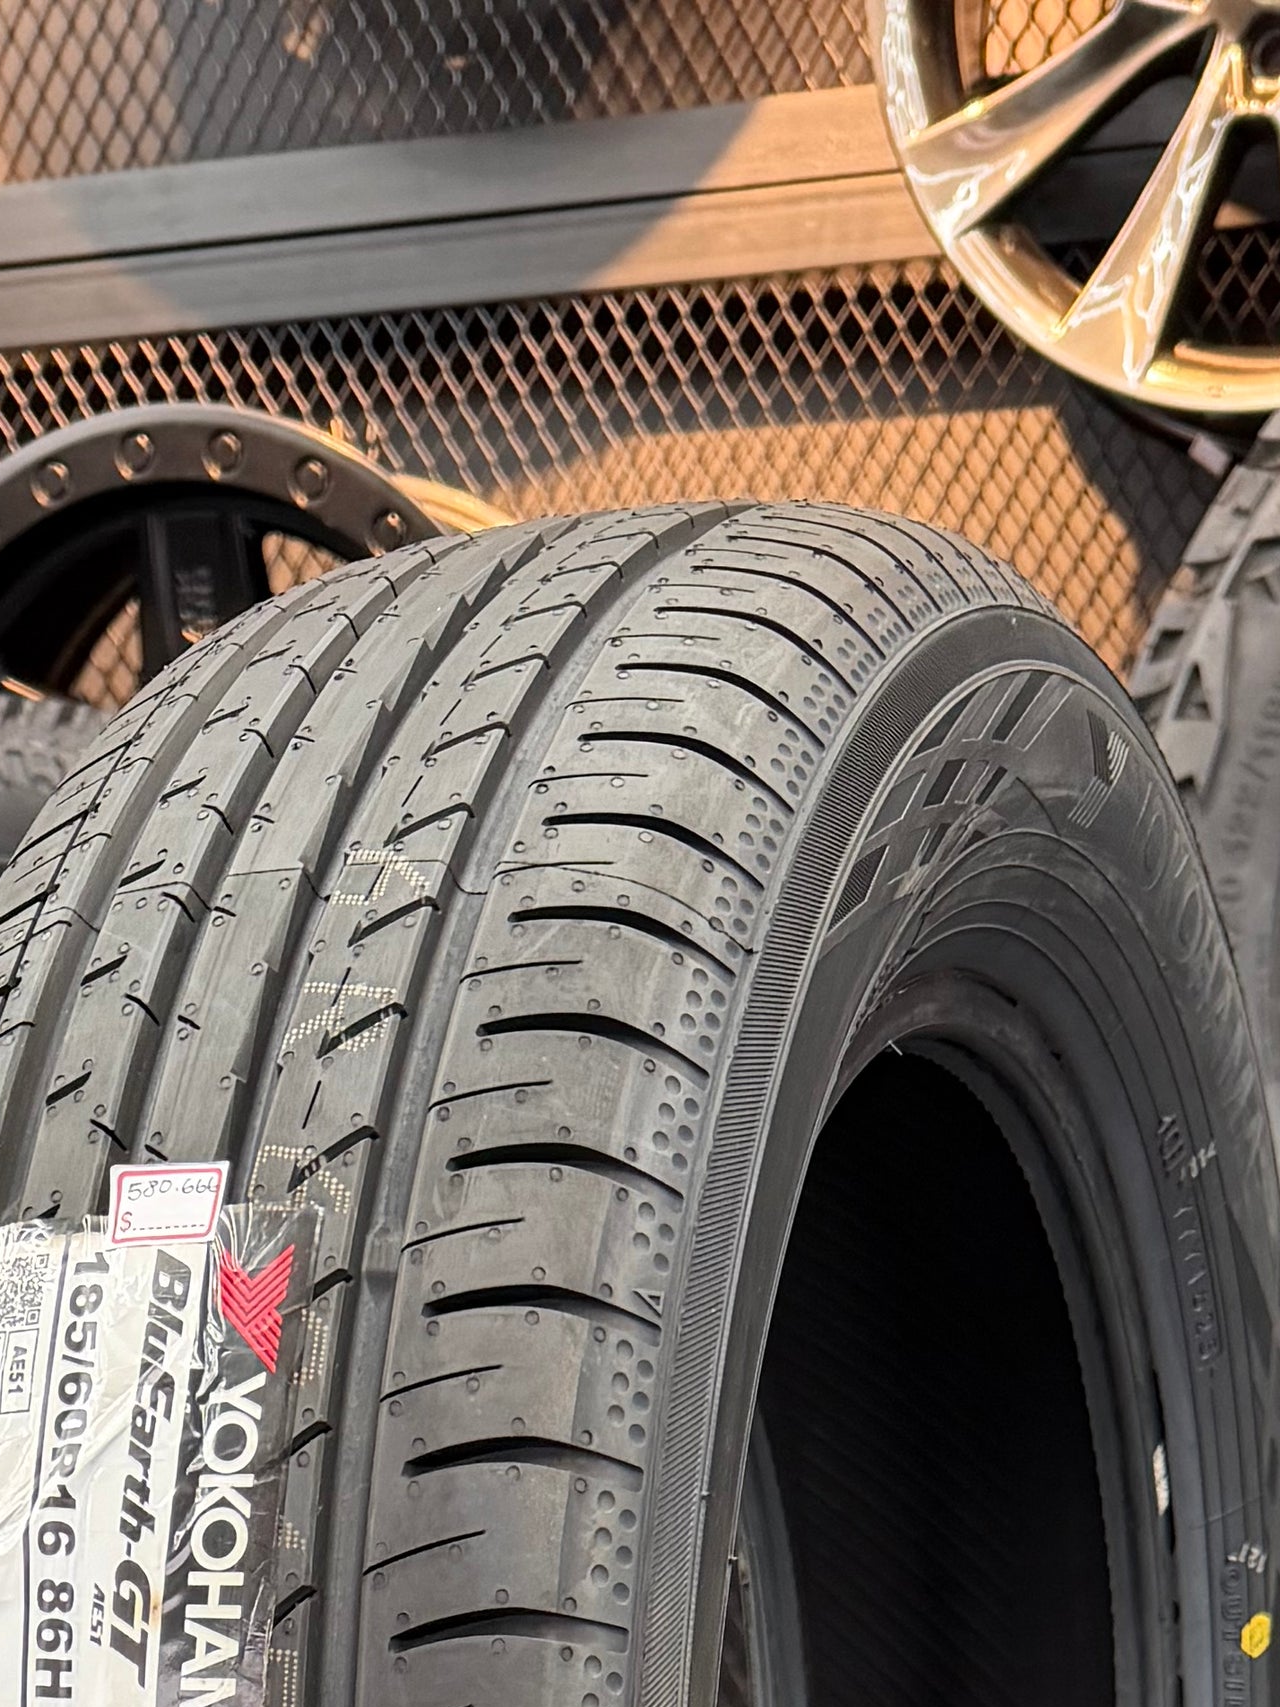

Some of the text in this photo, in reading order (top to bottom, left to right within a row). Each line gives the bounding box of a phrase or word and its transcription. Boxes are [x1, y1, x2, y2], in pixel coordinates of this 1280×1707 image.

[6, 1345, 28, 1395] AE51
[33, 1254, 111, 1699] 185/60R16 86H
[108, 1249, 194, 1688] BluEarth-GT
[89, 1582, 106, 1647] AE51
